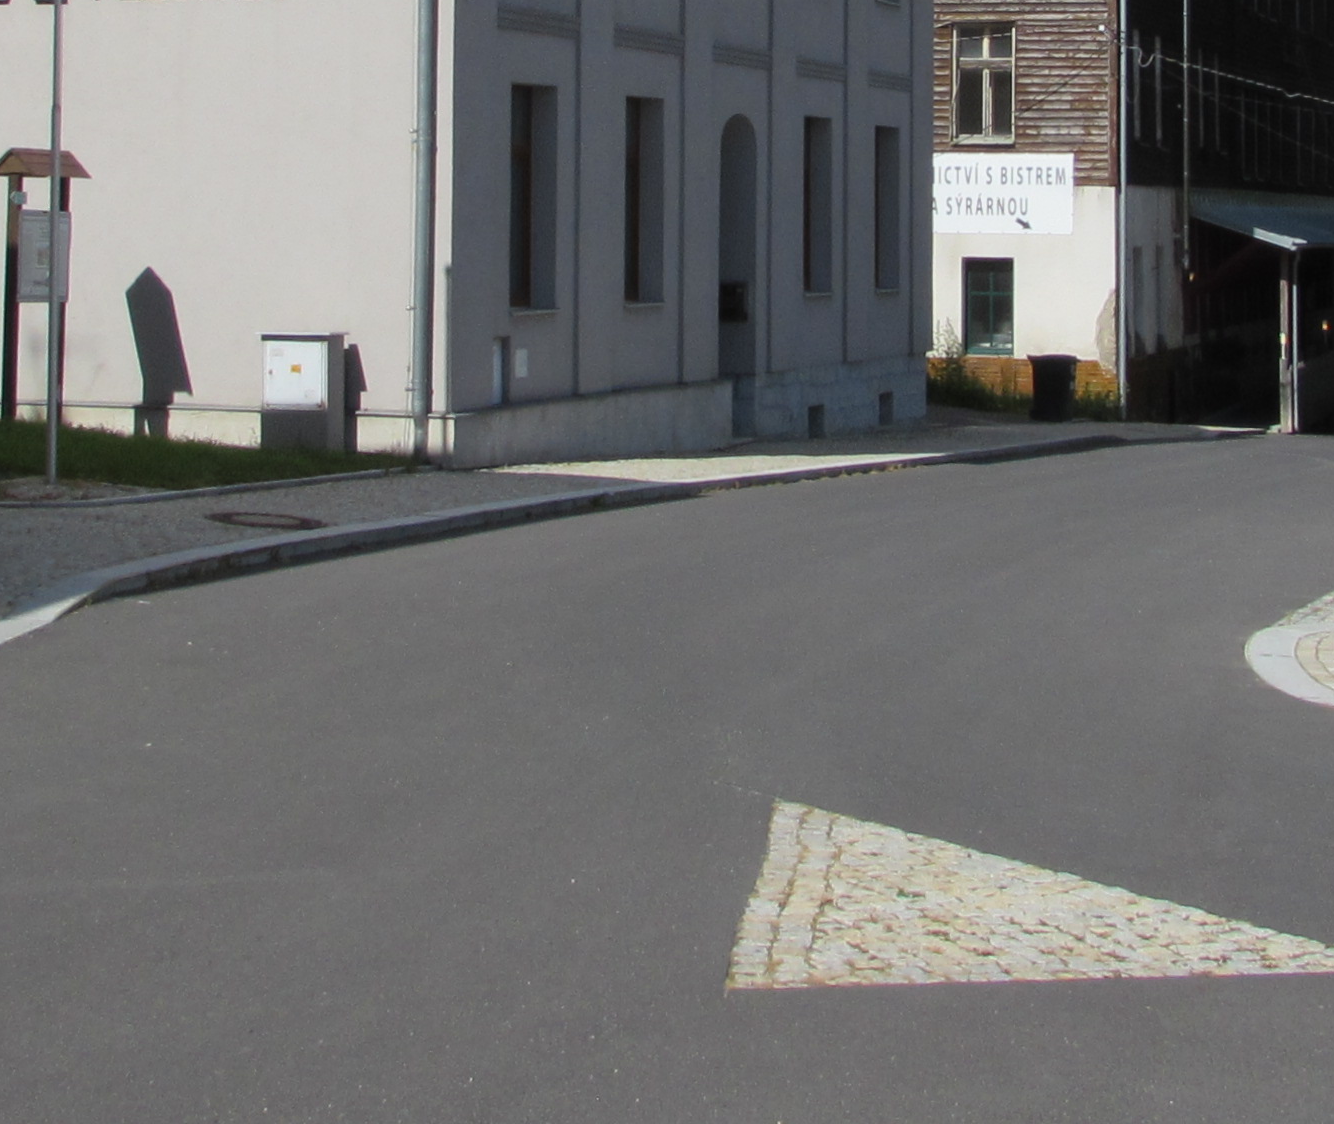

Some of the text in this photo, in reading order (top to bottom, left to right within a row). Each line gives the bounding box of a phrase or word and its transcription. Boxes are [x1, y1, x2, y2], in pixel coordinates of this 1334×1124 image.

[932, 162, 1066, 186] ICTVÍ S BISTREM
[946, 193, 1029, 216] SÝRÁRNOU
